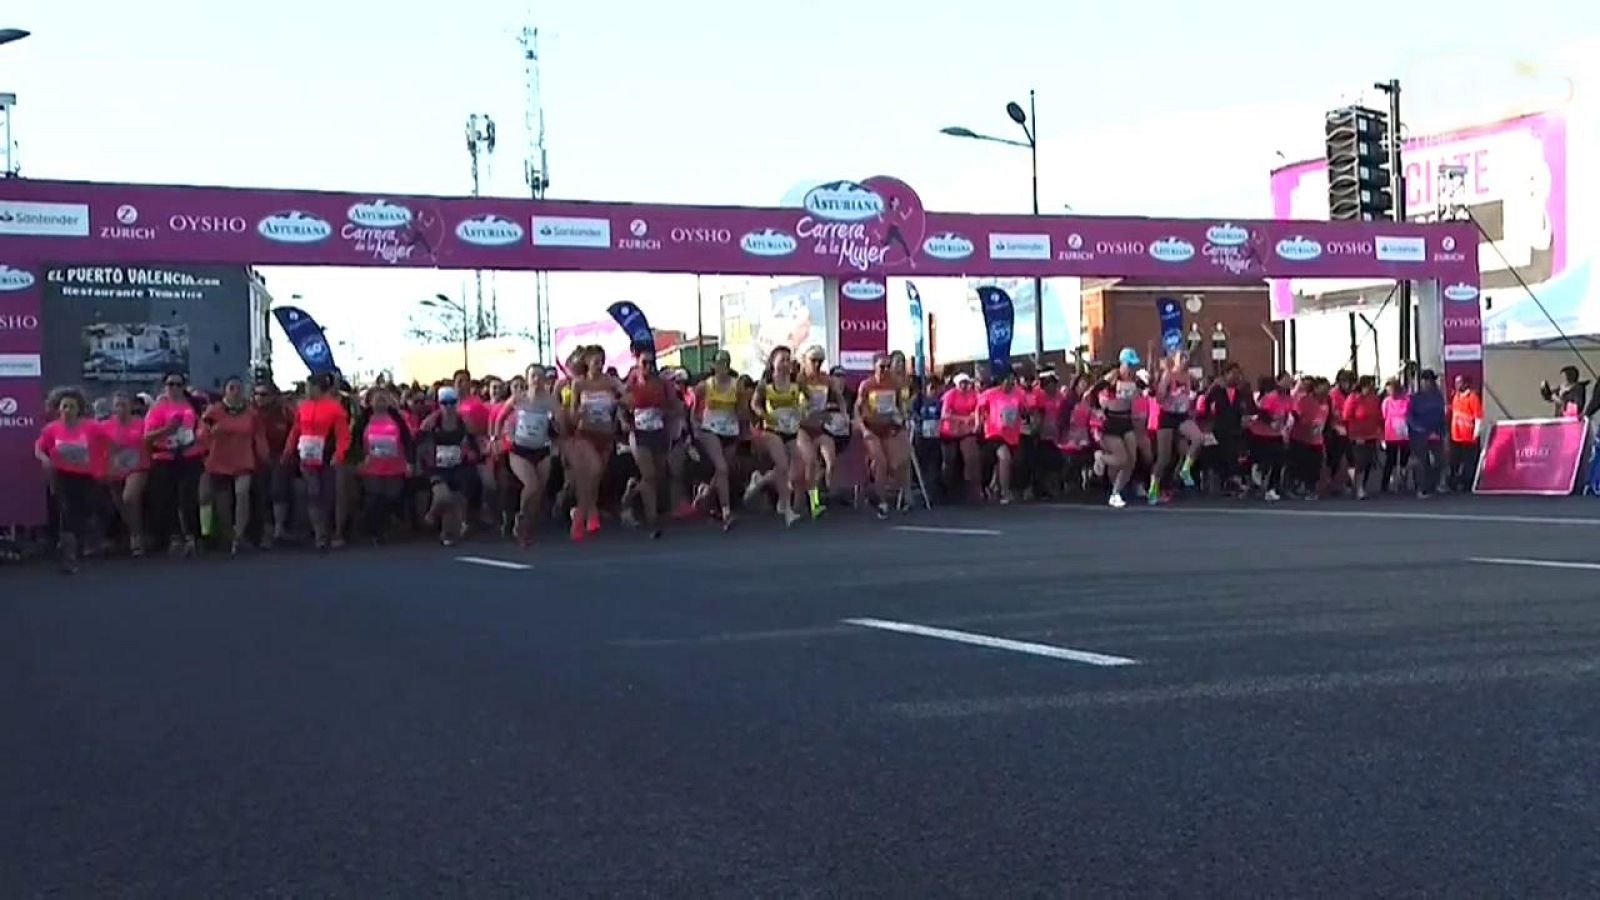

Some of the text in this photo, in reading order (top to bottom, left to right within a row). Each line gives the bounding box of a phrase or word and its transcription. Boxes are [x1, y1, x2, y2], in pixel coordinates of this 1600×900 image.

[811, 194, 880, 210] ASTURIANA
[15, 212, 79, 225] Santander
[169, 214, 246, 232] OYSHO
[101, 227, 155, 239] ZURICH
[263, 221, 326, 235] ASTURIANA
[341, 223, 396, 240] Carrera
[462, 225, 517, 237] ASTURIANA
[796, 216, 865, 239] Carrera
[671, 228, 731, 243] OYSHO
[374, 239, 415, 264] Mujer
[619, 238, 661, 250] ZURICH
[1096, 240, 1145, 255] OYSHO
[1327, 240, 1372, 255] OYSHO
[838, 238, 890, 271] Mujer
[47, 269, 65, 281] EL
[67, 267, 123, 284] PUERTO
[62, 286, 143, 298] Restaurante
[841, 319, 887, 331] OYSHO
